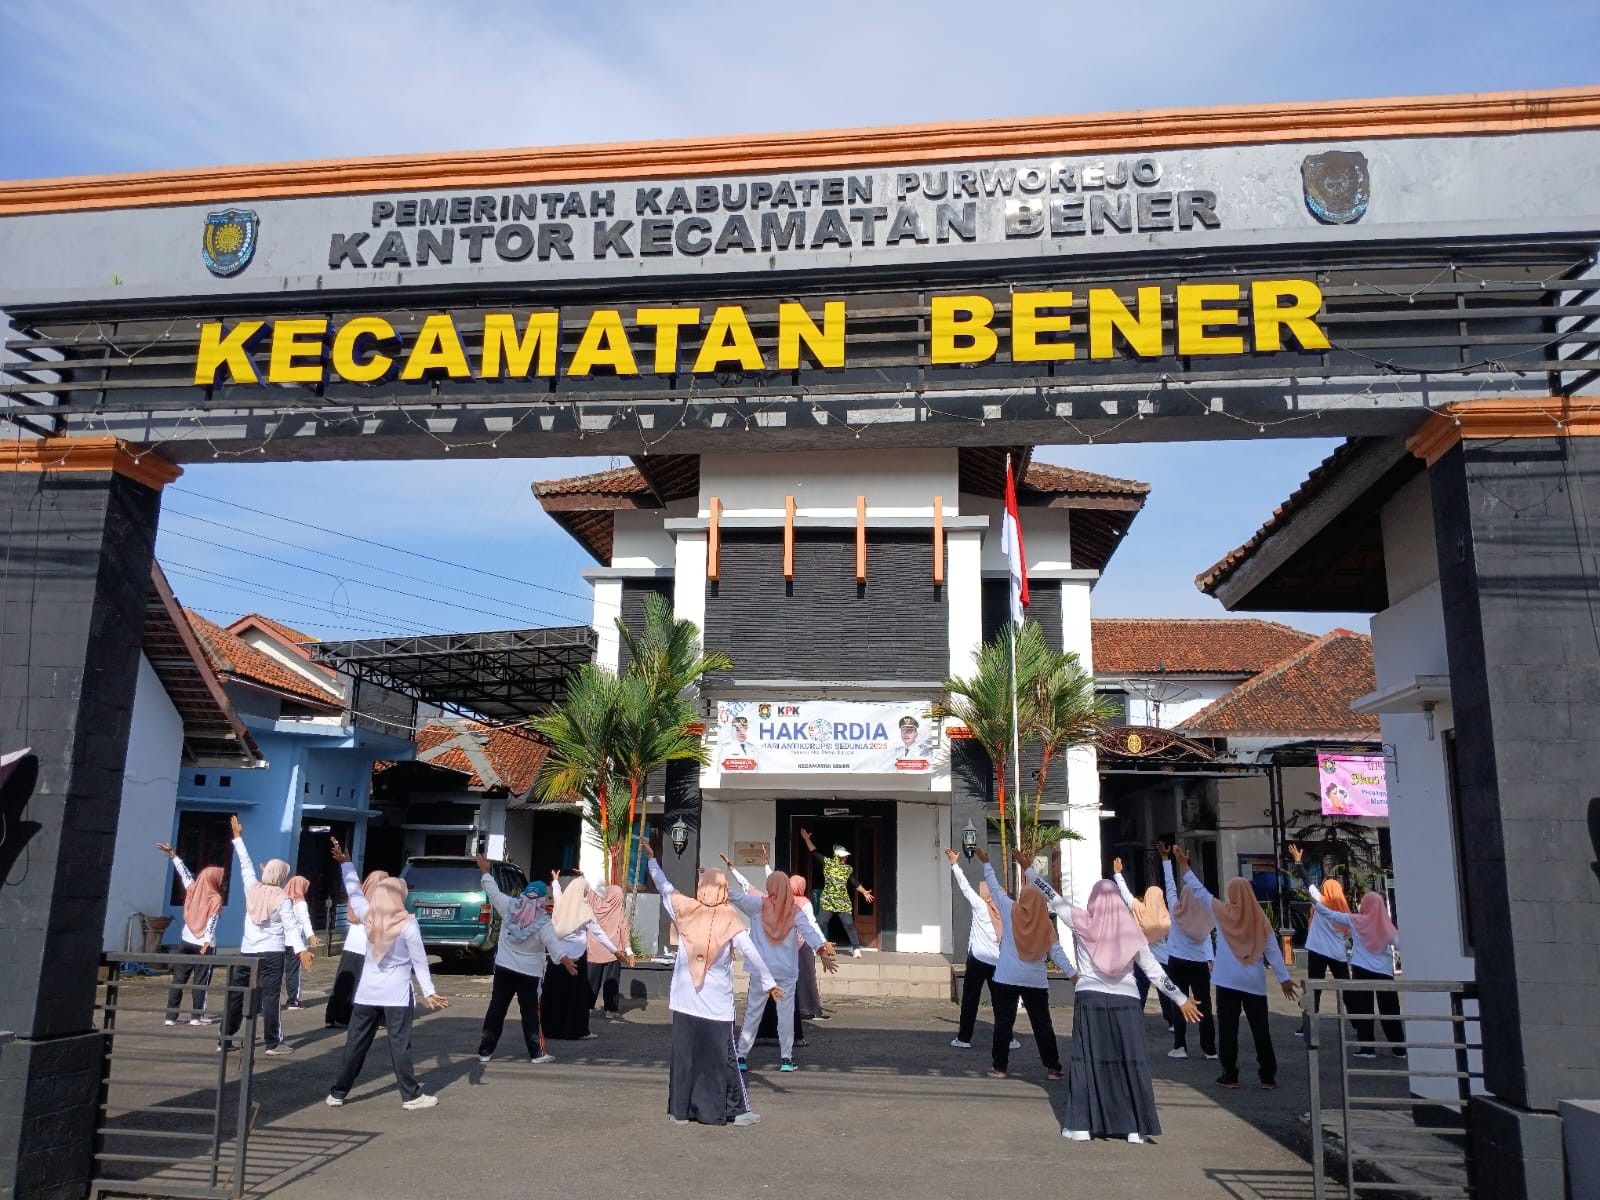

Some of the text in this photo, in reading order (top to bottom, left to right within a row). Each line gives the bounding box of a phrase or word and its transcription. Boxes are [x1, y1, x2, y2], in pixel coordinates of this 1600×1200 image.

[371, 158, 1162, 227] PEMERINTAH KABUPATEN PURWOREJO
[328, 190, 1221, 268] KANTOR KECAMATAN BENER
[193, 279, 1332, 387] KECAMATAN BENER
[777, 706, 800, 715] KPK
[760, 742, 780, 750] HARI
[780, 742, 833, 750] ANTIKORUPSI
[834, 742, 869, 750] SEDUNIA
